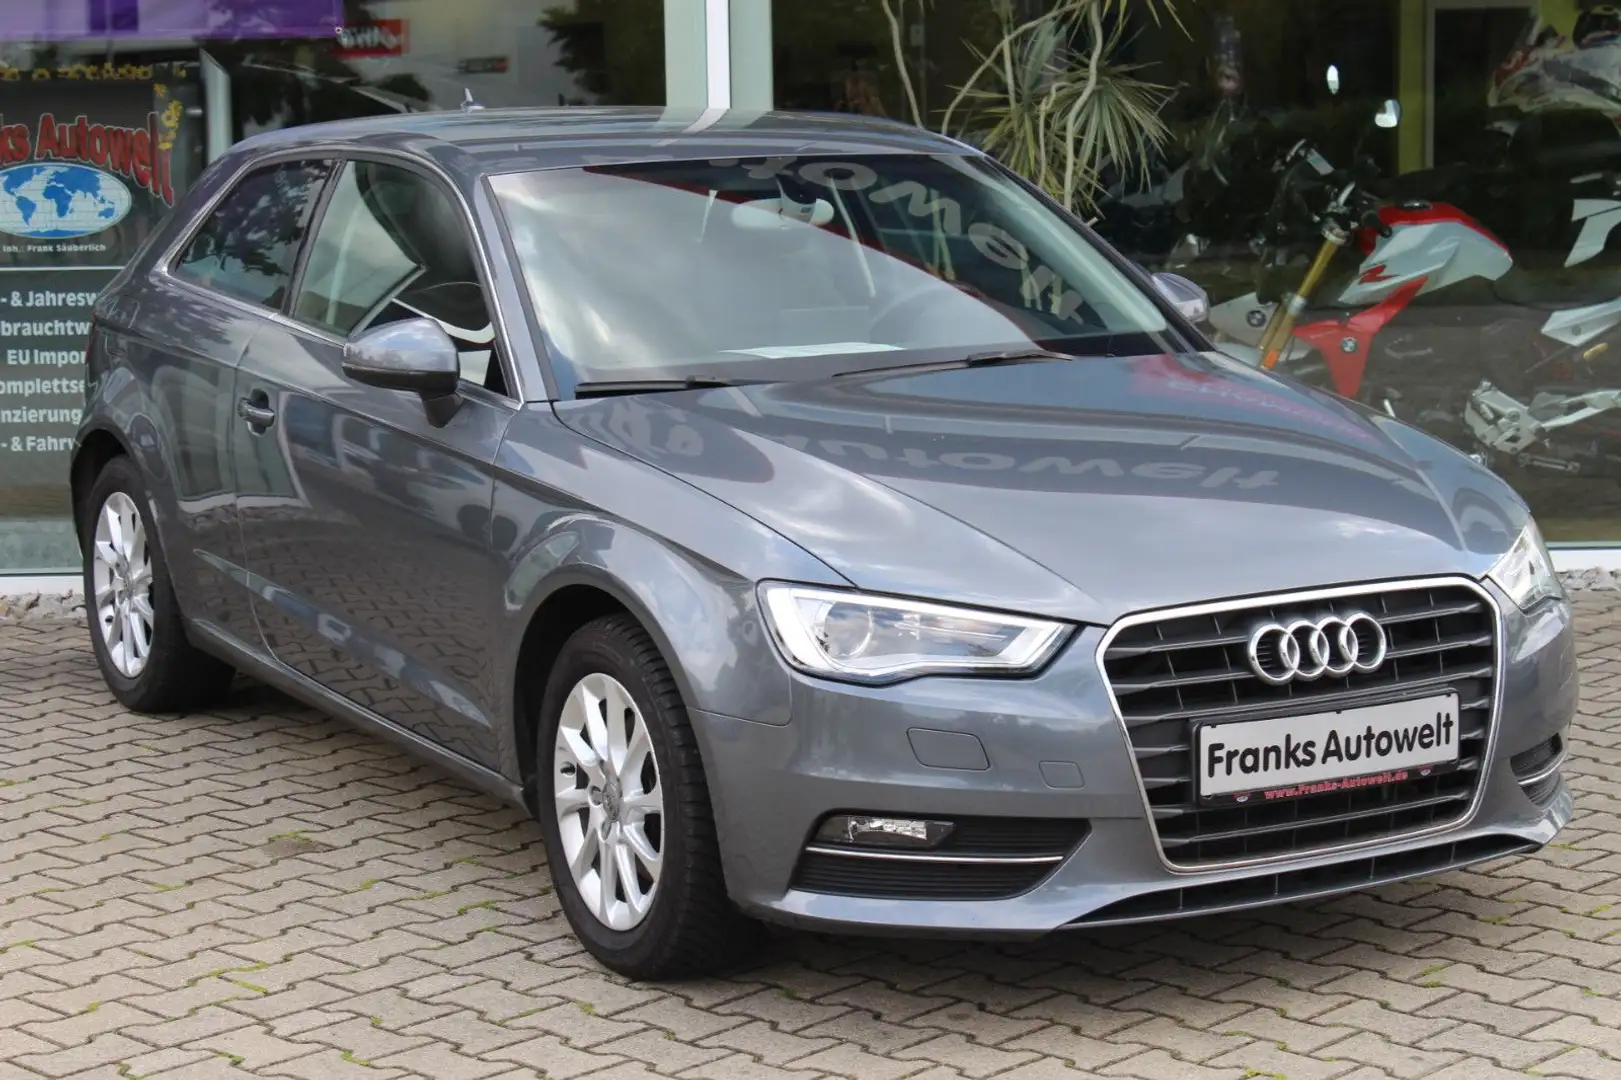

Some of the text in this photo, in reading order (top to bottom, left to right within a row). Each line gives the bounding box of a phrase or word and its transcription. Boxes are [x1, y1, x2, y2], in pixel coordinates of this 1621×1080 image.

[27, 244, 54, 253] Frank
[11, 290, 23, 307] &
[7, 349, 31, 365] EU
[11, 436, 23, 452] &
[1207, 711, 1454, 778] Franks Autowelt
